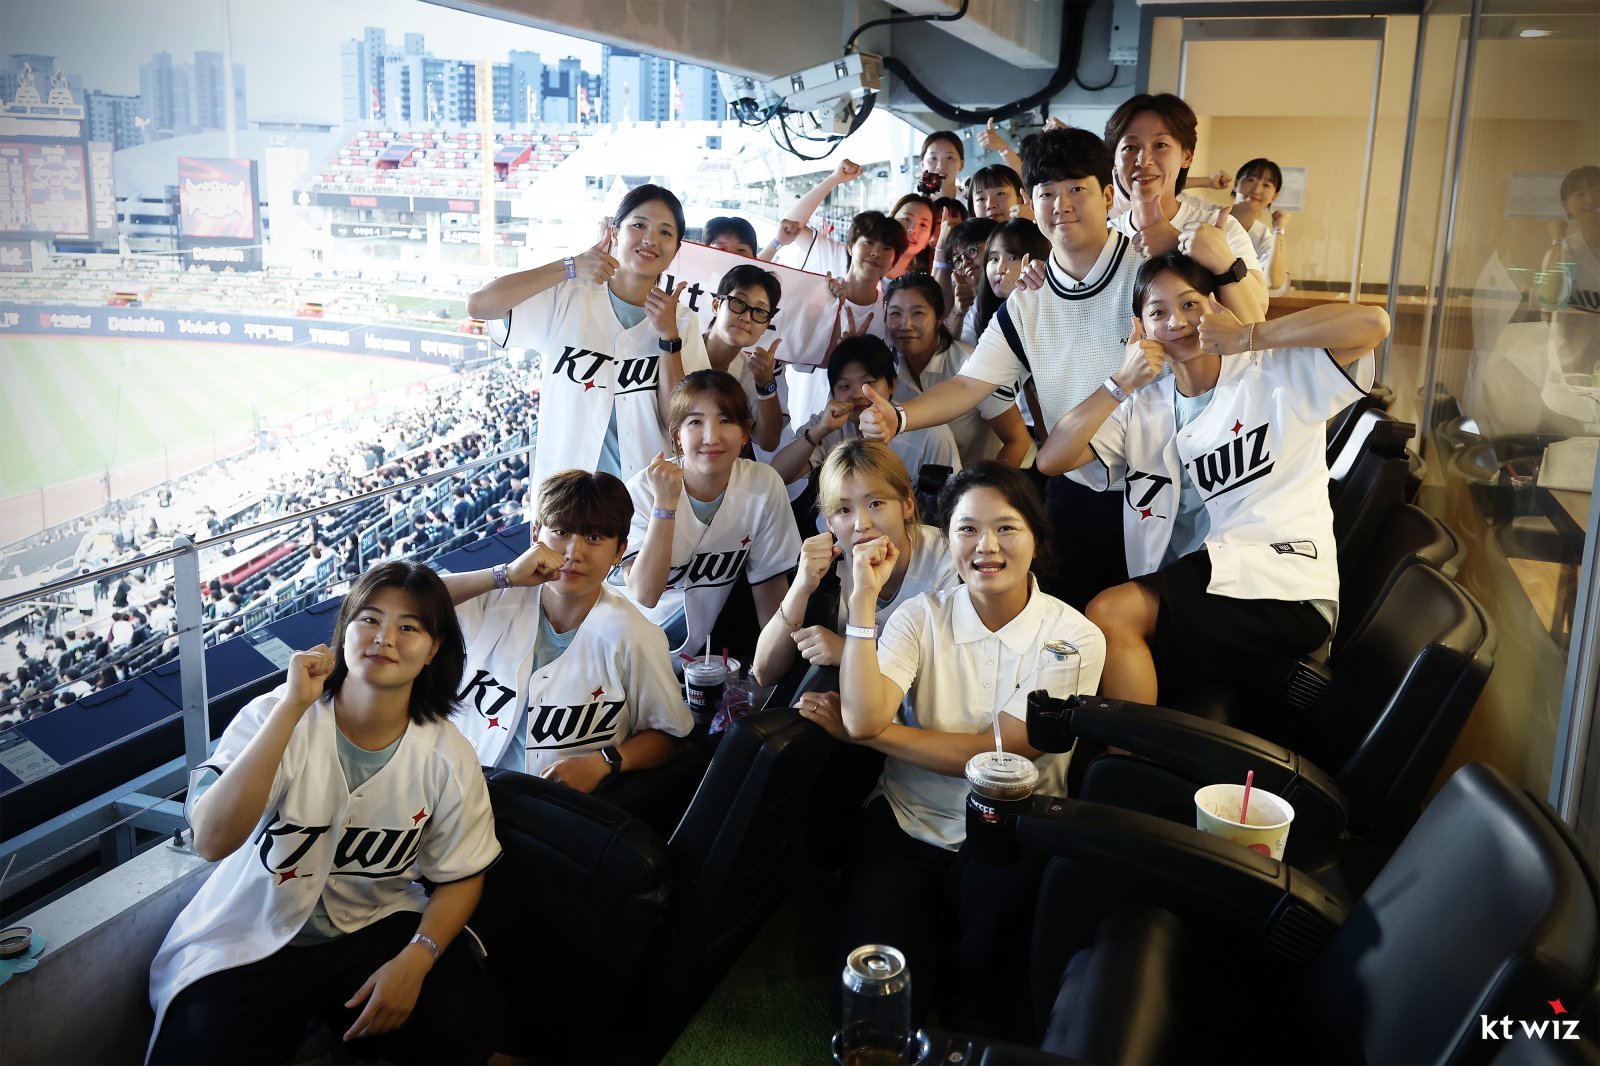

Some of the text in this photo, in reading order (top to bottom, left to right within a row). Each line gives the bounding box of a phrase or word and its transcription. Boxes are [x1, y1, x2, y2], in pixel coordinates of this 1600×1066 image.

[552, 345, 613, 384] KT
[1193, 418, 1270, 492] WIZ
[458, 669, 626, 744] KT WIZ
